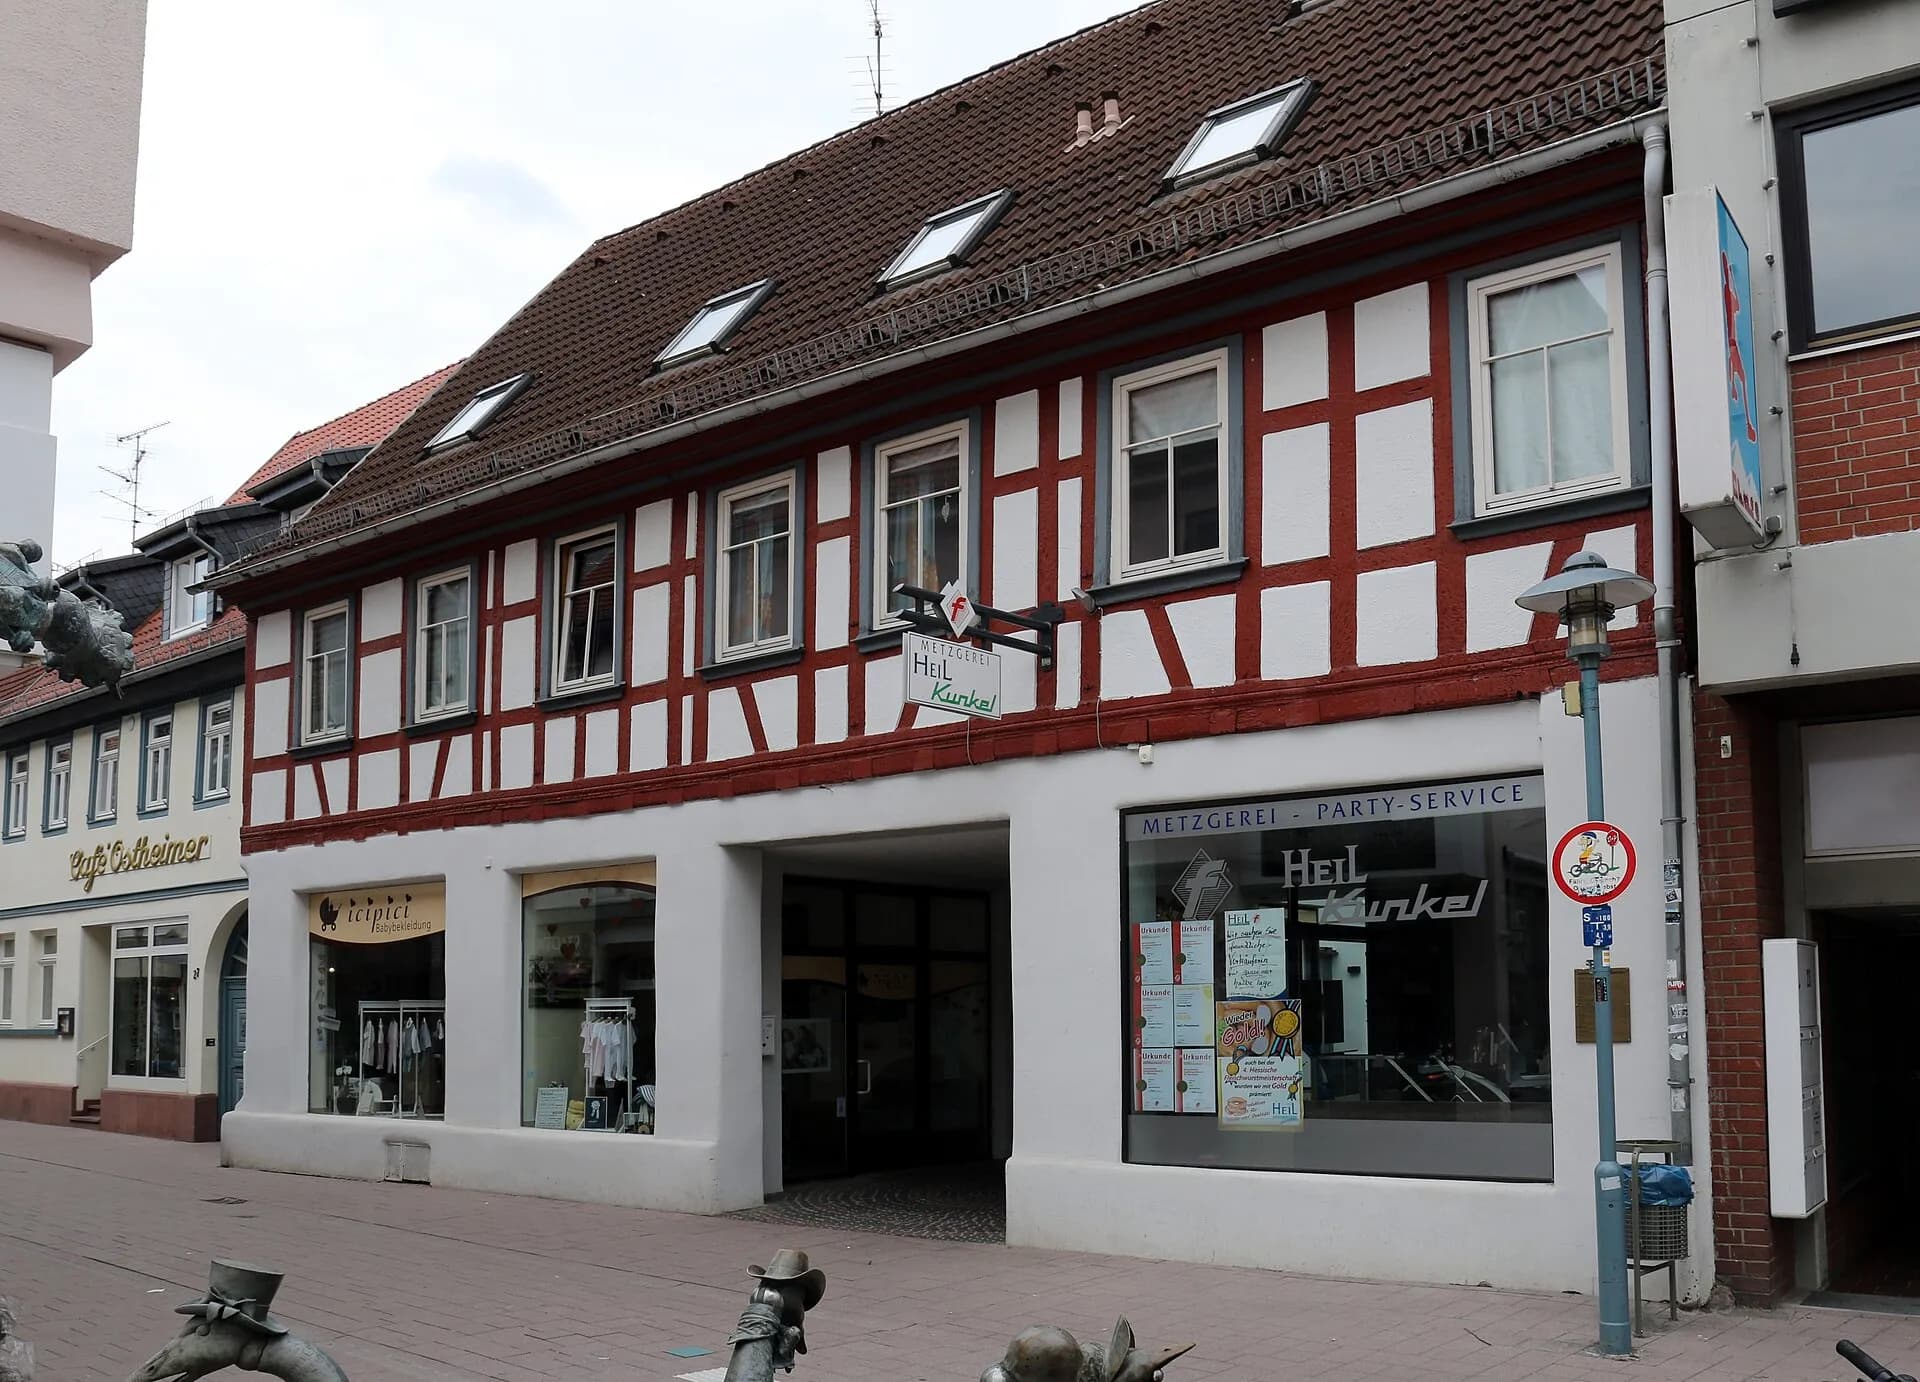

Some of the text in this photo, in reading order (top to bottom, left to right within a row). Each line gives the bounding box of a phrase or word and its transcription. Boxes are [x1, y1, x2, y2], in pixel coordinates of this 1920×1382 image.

[921, 640, 990, 667] METZGEREI
[931, 681, 997, 712] Kunkel
[1143, 808, 1276, 835] METZGEREI
[1318, 784, 1524, 820] PARTY-SERVICE
[110, 833, 209, 873] Ostheimer
[348, 894, 412, 933] icipici
[1318, 880, 1488, 925] Kunkel
[375, 920, 432, 934] Babybekleidung
[1182, 925, 1211, 933] Urkunde
[1223, 1019, 1265, 1046] Gold!
[1225, 1011, 1254, 1025] Wieder
